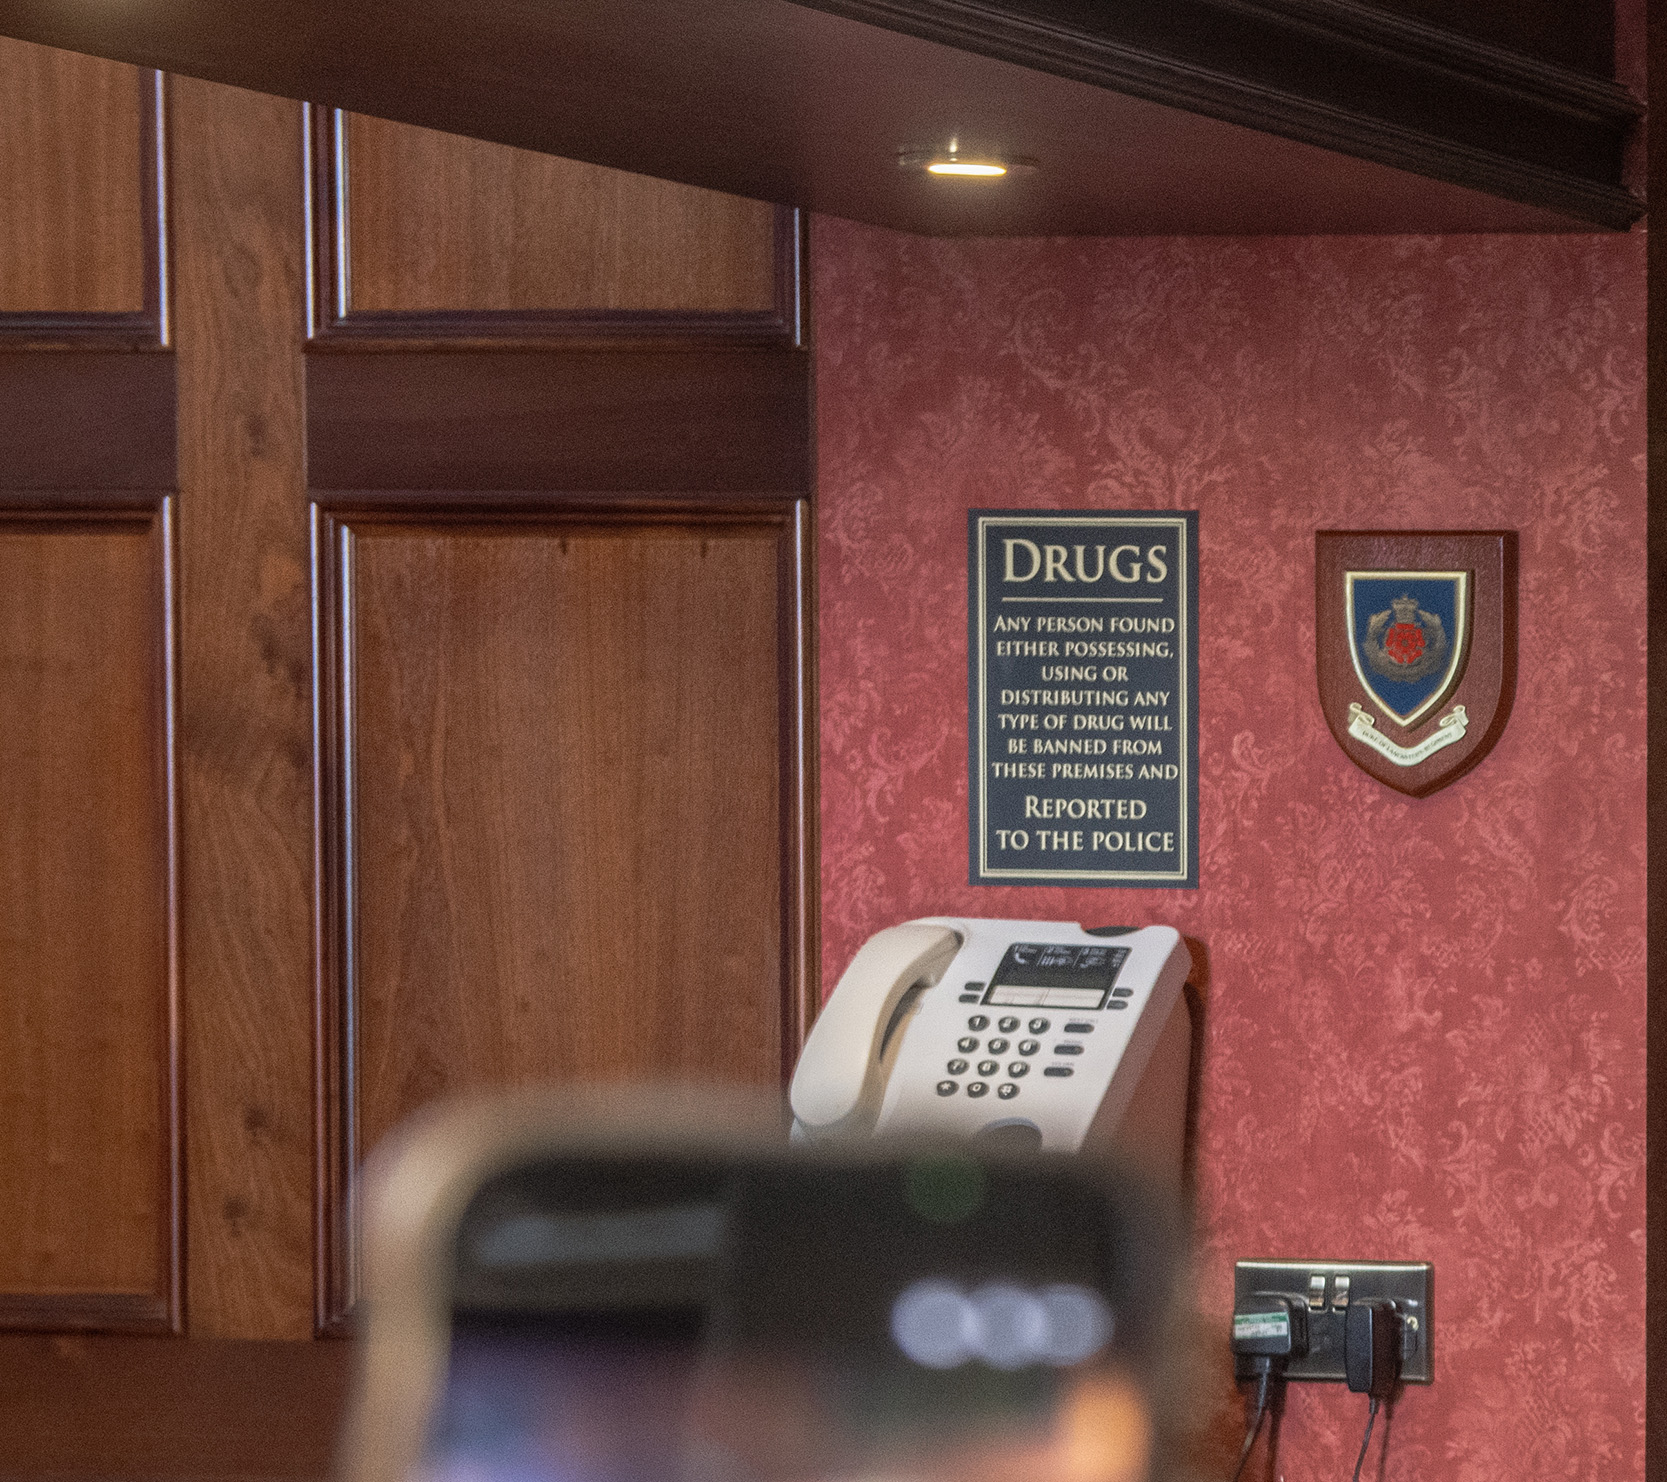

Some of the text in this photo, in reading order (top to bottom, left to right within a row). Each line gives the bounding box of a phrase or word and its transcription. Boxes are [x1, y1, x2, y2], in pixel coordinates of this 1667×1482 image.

[1003, 538, 1168, 583] DRUGS
[994, 616, 1176, 633] ANY PERSON FOUND
[996, 641, 1175, 659] EITHER POSSESSING,
[1041, 665, 1129, 682] USING OR
[1001, 689, 1171, 706] DISTRIBUTING ANY
[998, 714, 1173, 731] TYPE OF DRUG WILL
[1008, 739, 1162, 755] BE BANNED FROM
[992, 762, 1179, 780] THESE PREMISES AND
[1024, 795, 1148, 820] REPORTED
[996, 830, 1175, 852] TO THE POLICE
